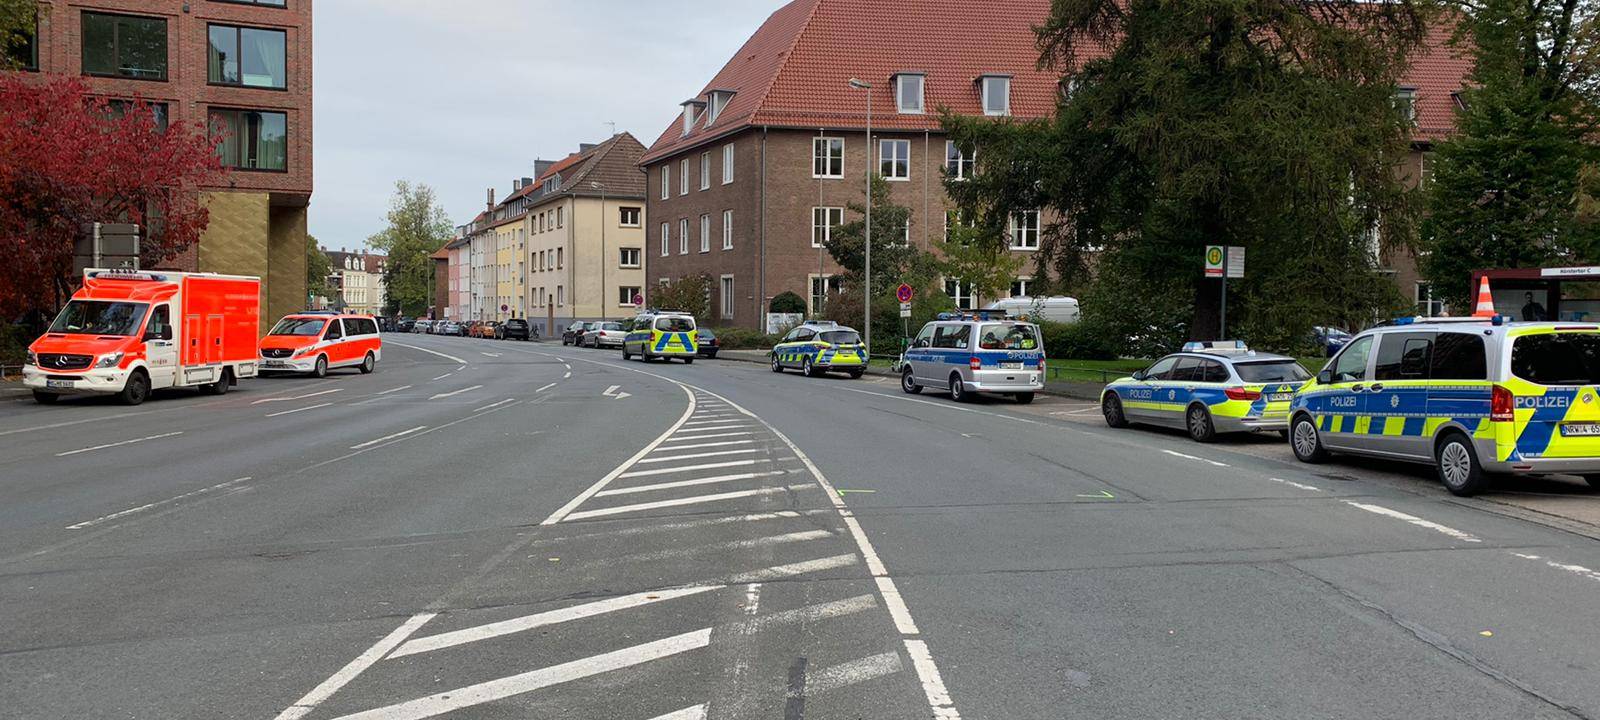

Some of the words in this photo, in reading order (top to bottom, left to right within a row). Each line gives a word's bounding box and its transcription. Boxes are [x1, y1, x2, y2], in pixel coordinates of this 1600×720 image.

[1013, 352, 1039, 360] POLIZEI
[1130, 389, 1153, 399] POLIZEI
[1330, 396, 1357, 407] POLIZEI
[1515, 396, 1569, 408] POLIZEI
